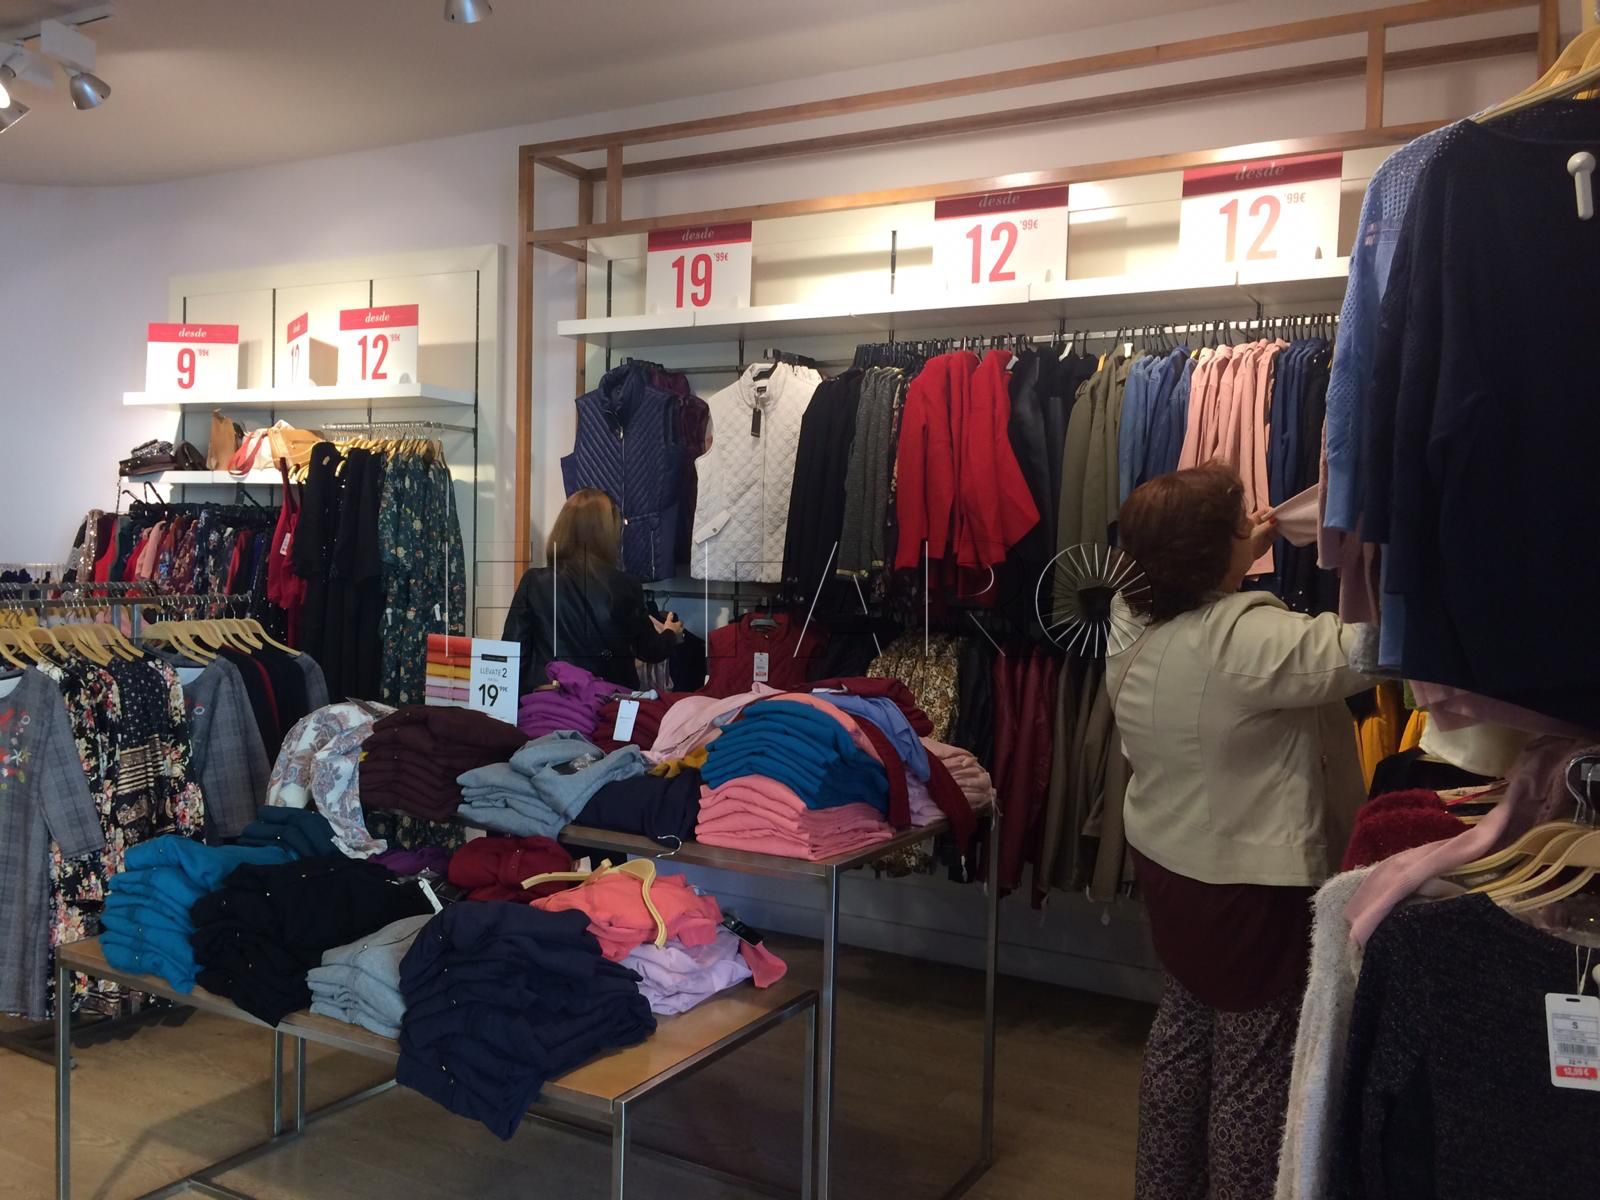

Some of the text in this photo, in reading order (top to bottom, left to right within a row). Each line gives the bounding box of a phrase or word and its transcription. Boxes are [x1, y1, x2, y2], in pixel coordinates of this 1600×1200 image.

[1234, 161, 1285, 181] desde
[978, 192, 1021, 208] desde
[681, 227, 715, 241] desde
[1219, 195, 1281, 263] 12
[965, 221, 1018, 284] 12
[672, 253, 712, 308] 19
[364, 312, 391, 323] desde
[178, 328, 208, 338] desde
[177, 347, 196, 390] 9
[358, 334, 389, 380] 12
[479, 683, 499, 707] 19
